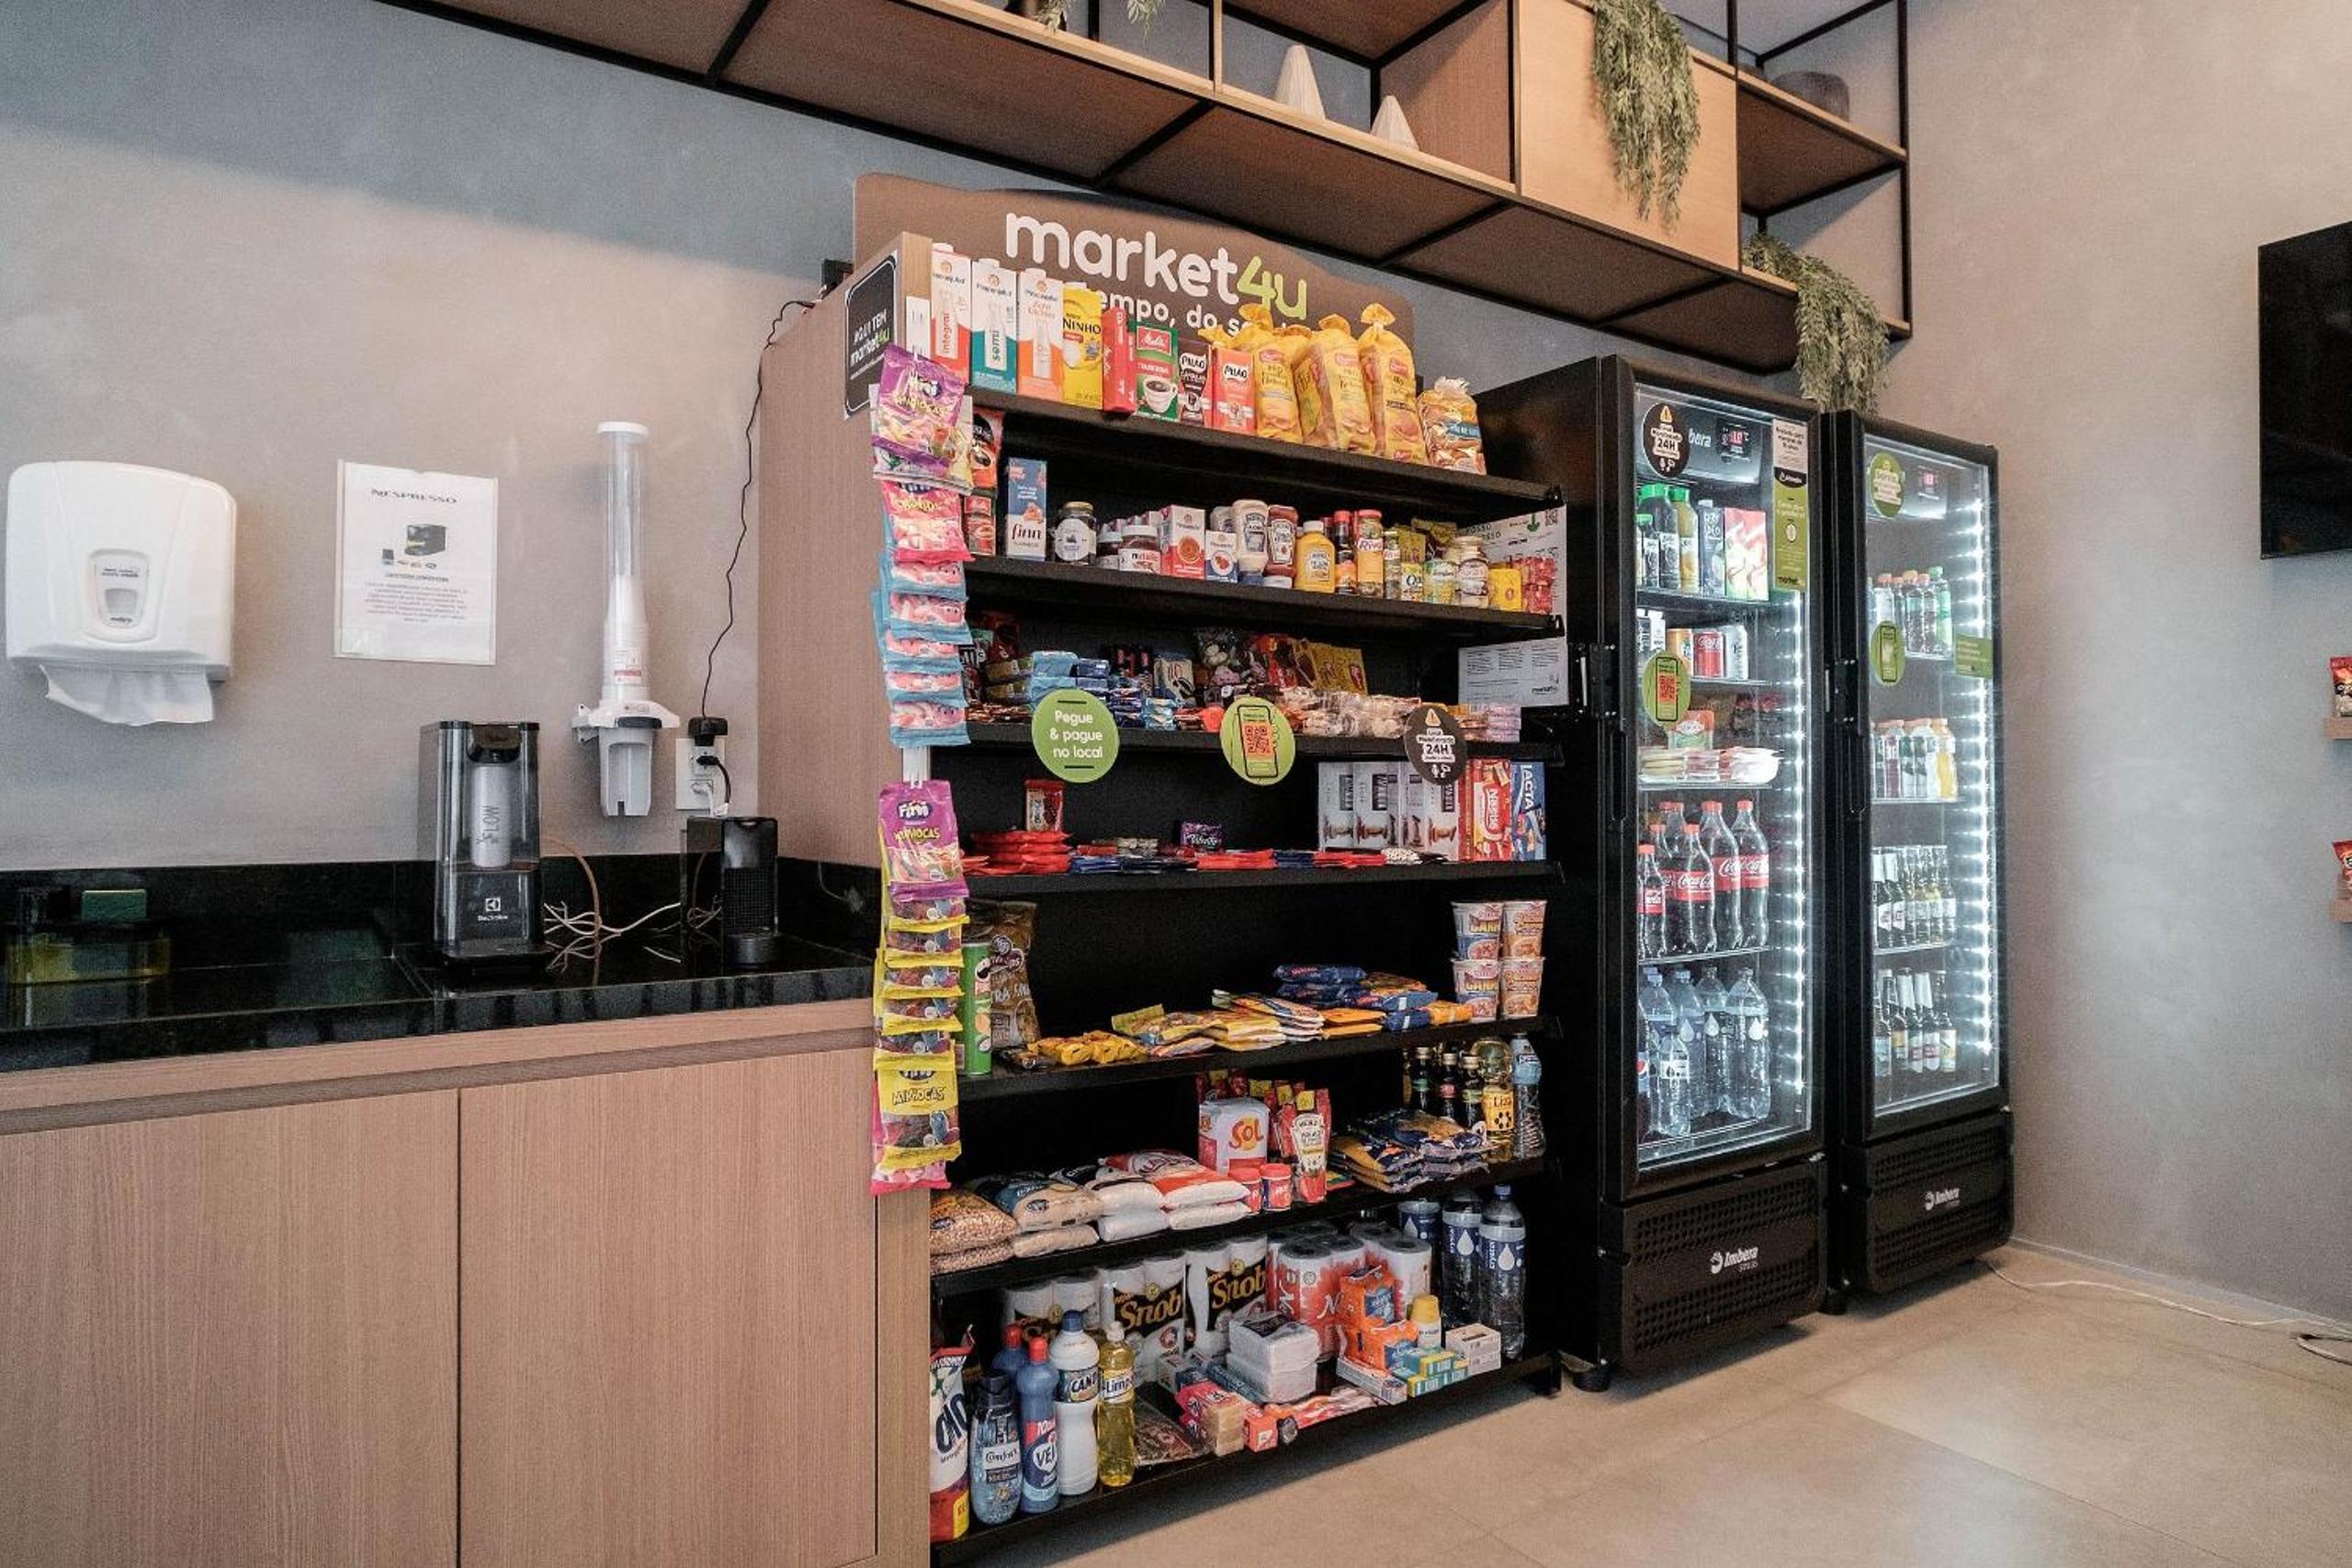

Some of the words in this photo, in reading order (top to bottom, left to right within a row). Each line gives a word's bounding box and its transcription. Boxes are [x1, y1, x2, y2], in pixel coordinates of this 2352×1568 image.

[1006, 212, 1307, 321] market4u
[1100, 291, 1176, 328] empo,
[1186, 304, 1218, 329] do
[1062, 317, 1102, 334] NINHO
[1657, 438, 1676, 451] 24H
[1688, 427, 1712, 448] bera
[1054, 709, 1094, 725] Pegue
[1049, 728, 1059, 739] &
[1062, 728, 1103, 745] pague
[1053, 745, 1069, 759] no
[1073, 745, 1103, 759] local
[1426, 744, 1449, 755] 24H
[1521, 764, 1533, 809] LACTA
[899, 802, 930, 818] Fini
[1229, 1117, 1265, 1149] Sol
[1212, 1266, 1266, 1309] Snob
[1120, 1290, 1182, 1330] Snob
